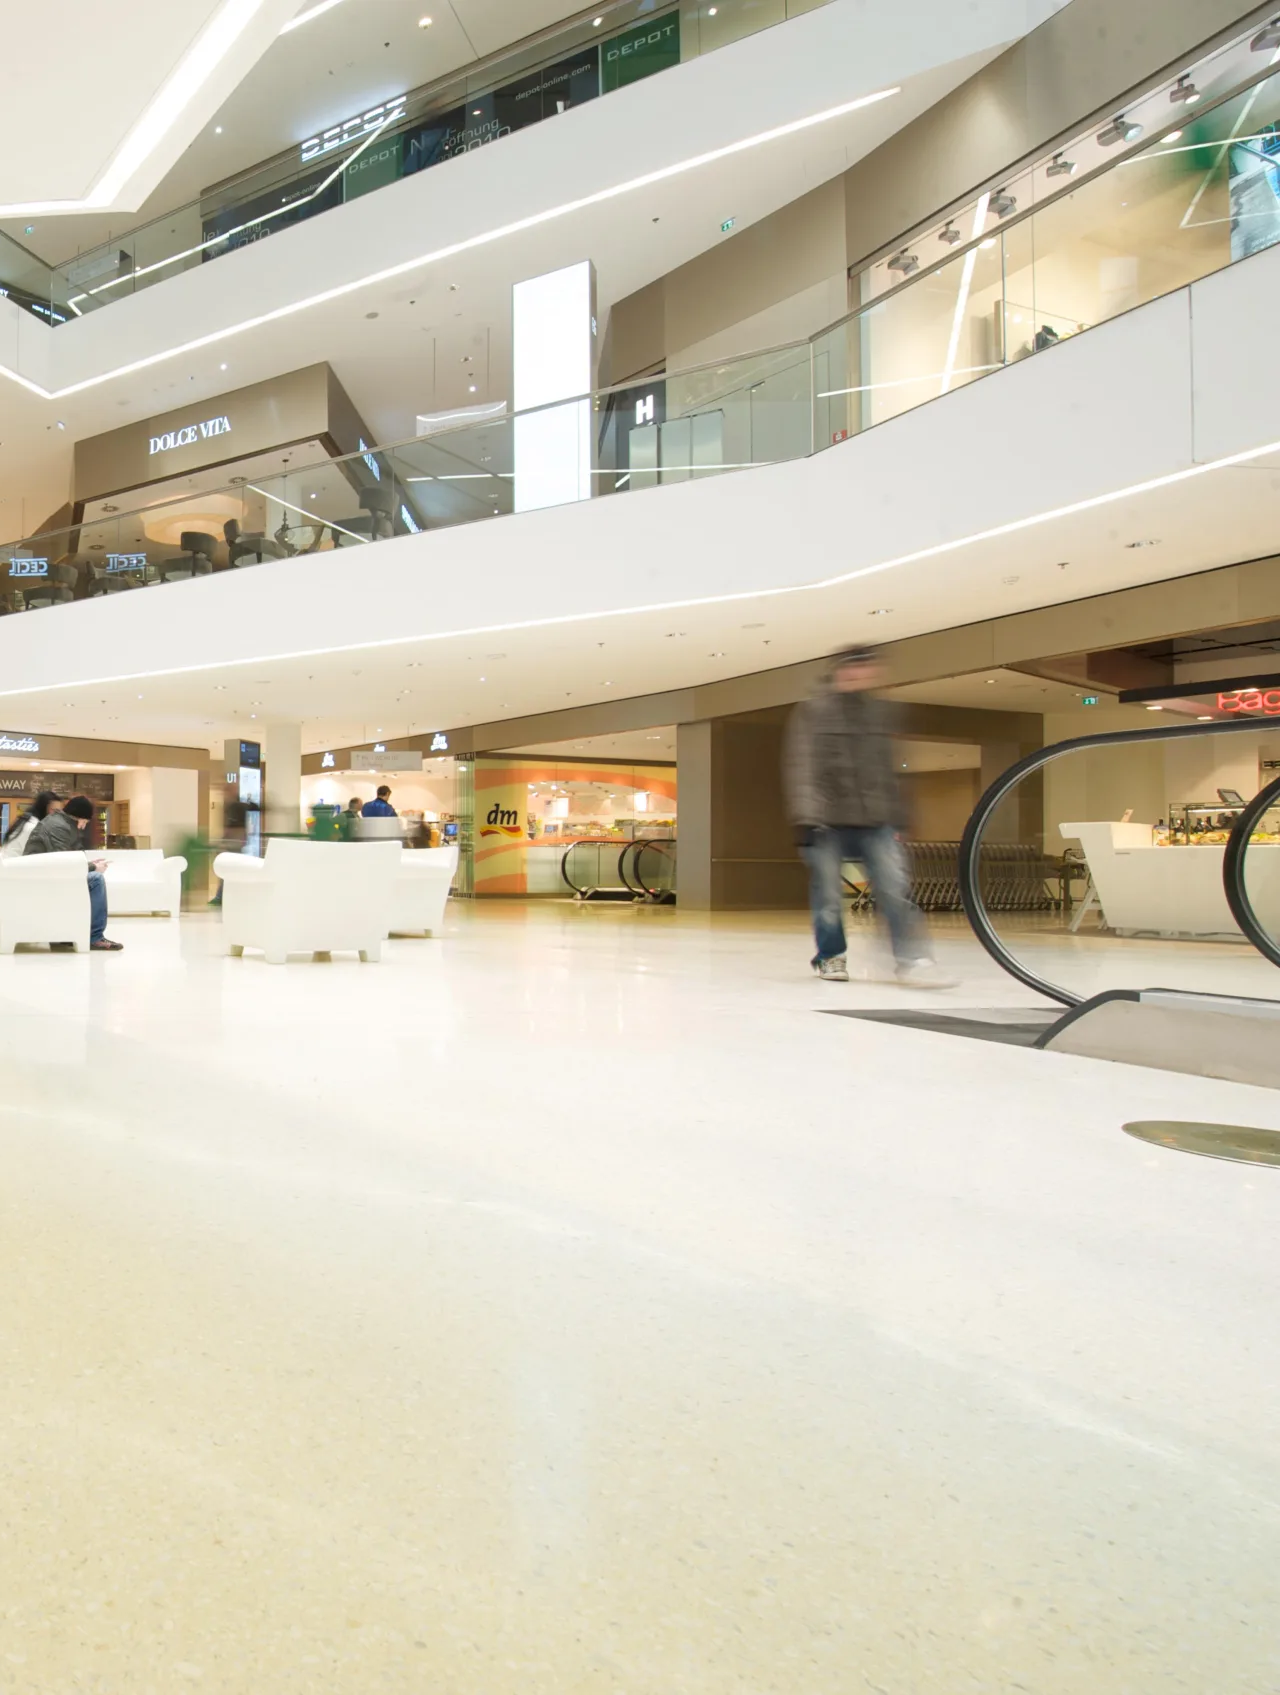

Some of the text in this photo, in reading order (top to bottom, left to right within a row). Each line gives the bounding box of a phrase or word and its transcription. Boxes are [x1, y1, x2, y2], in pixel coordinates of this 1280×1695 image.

[607, 24, 675, 62] DEPOT
[516, 62, 591, 101] depot-online.com
[348, 144, 400, 174] DEPOT
[149, 416, 231, 455] DOLCE VITA
[487, 803, 518, 825] dm
